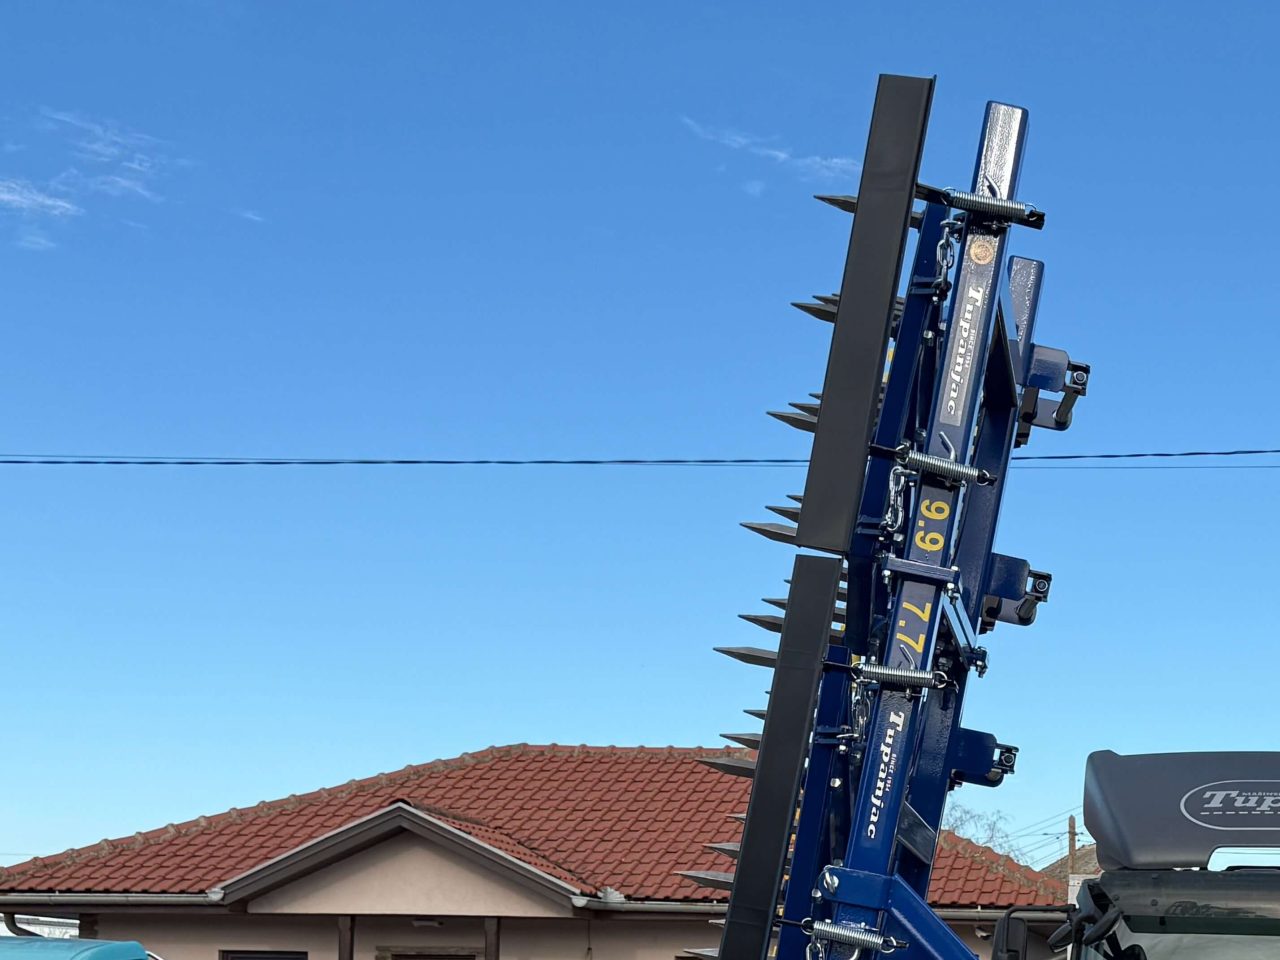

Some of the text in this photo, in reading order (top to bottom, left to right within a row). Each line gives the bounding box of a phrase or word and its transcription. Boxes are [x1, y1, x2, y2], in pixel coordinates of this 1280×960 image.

[946, 286, 984, 415] Tupanjac
[914, 499, 950, 551] 9.9
[896, 601, 932, 653] 7.7
[866, 711, 905, 839] Tupanjac
